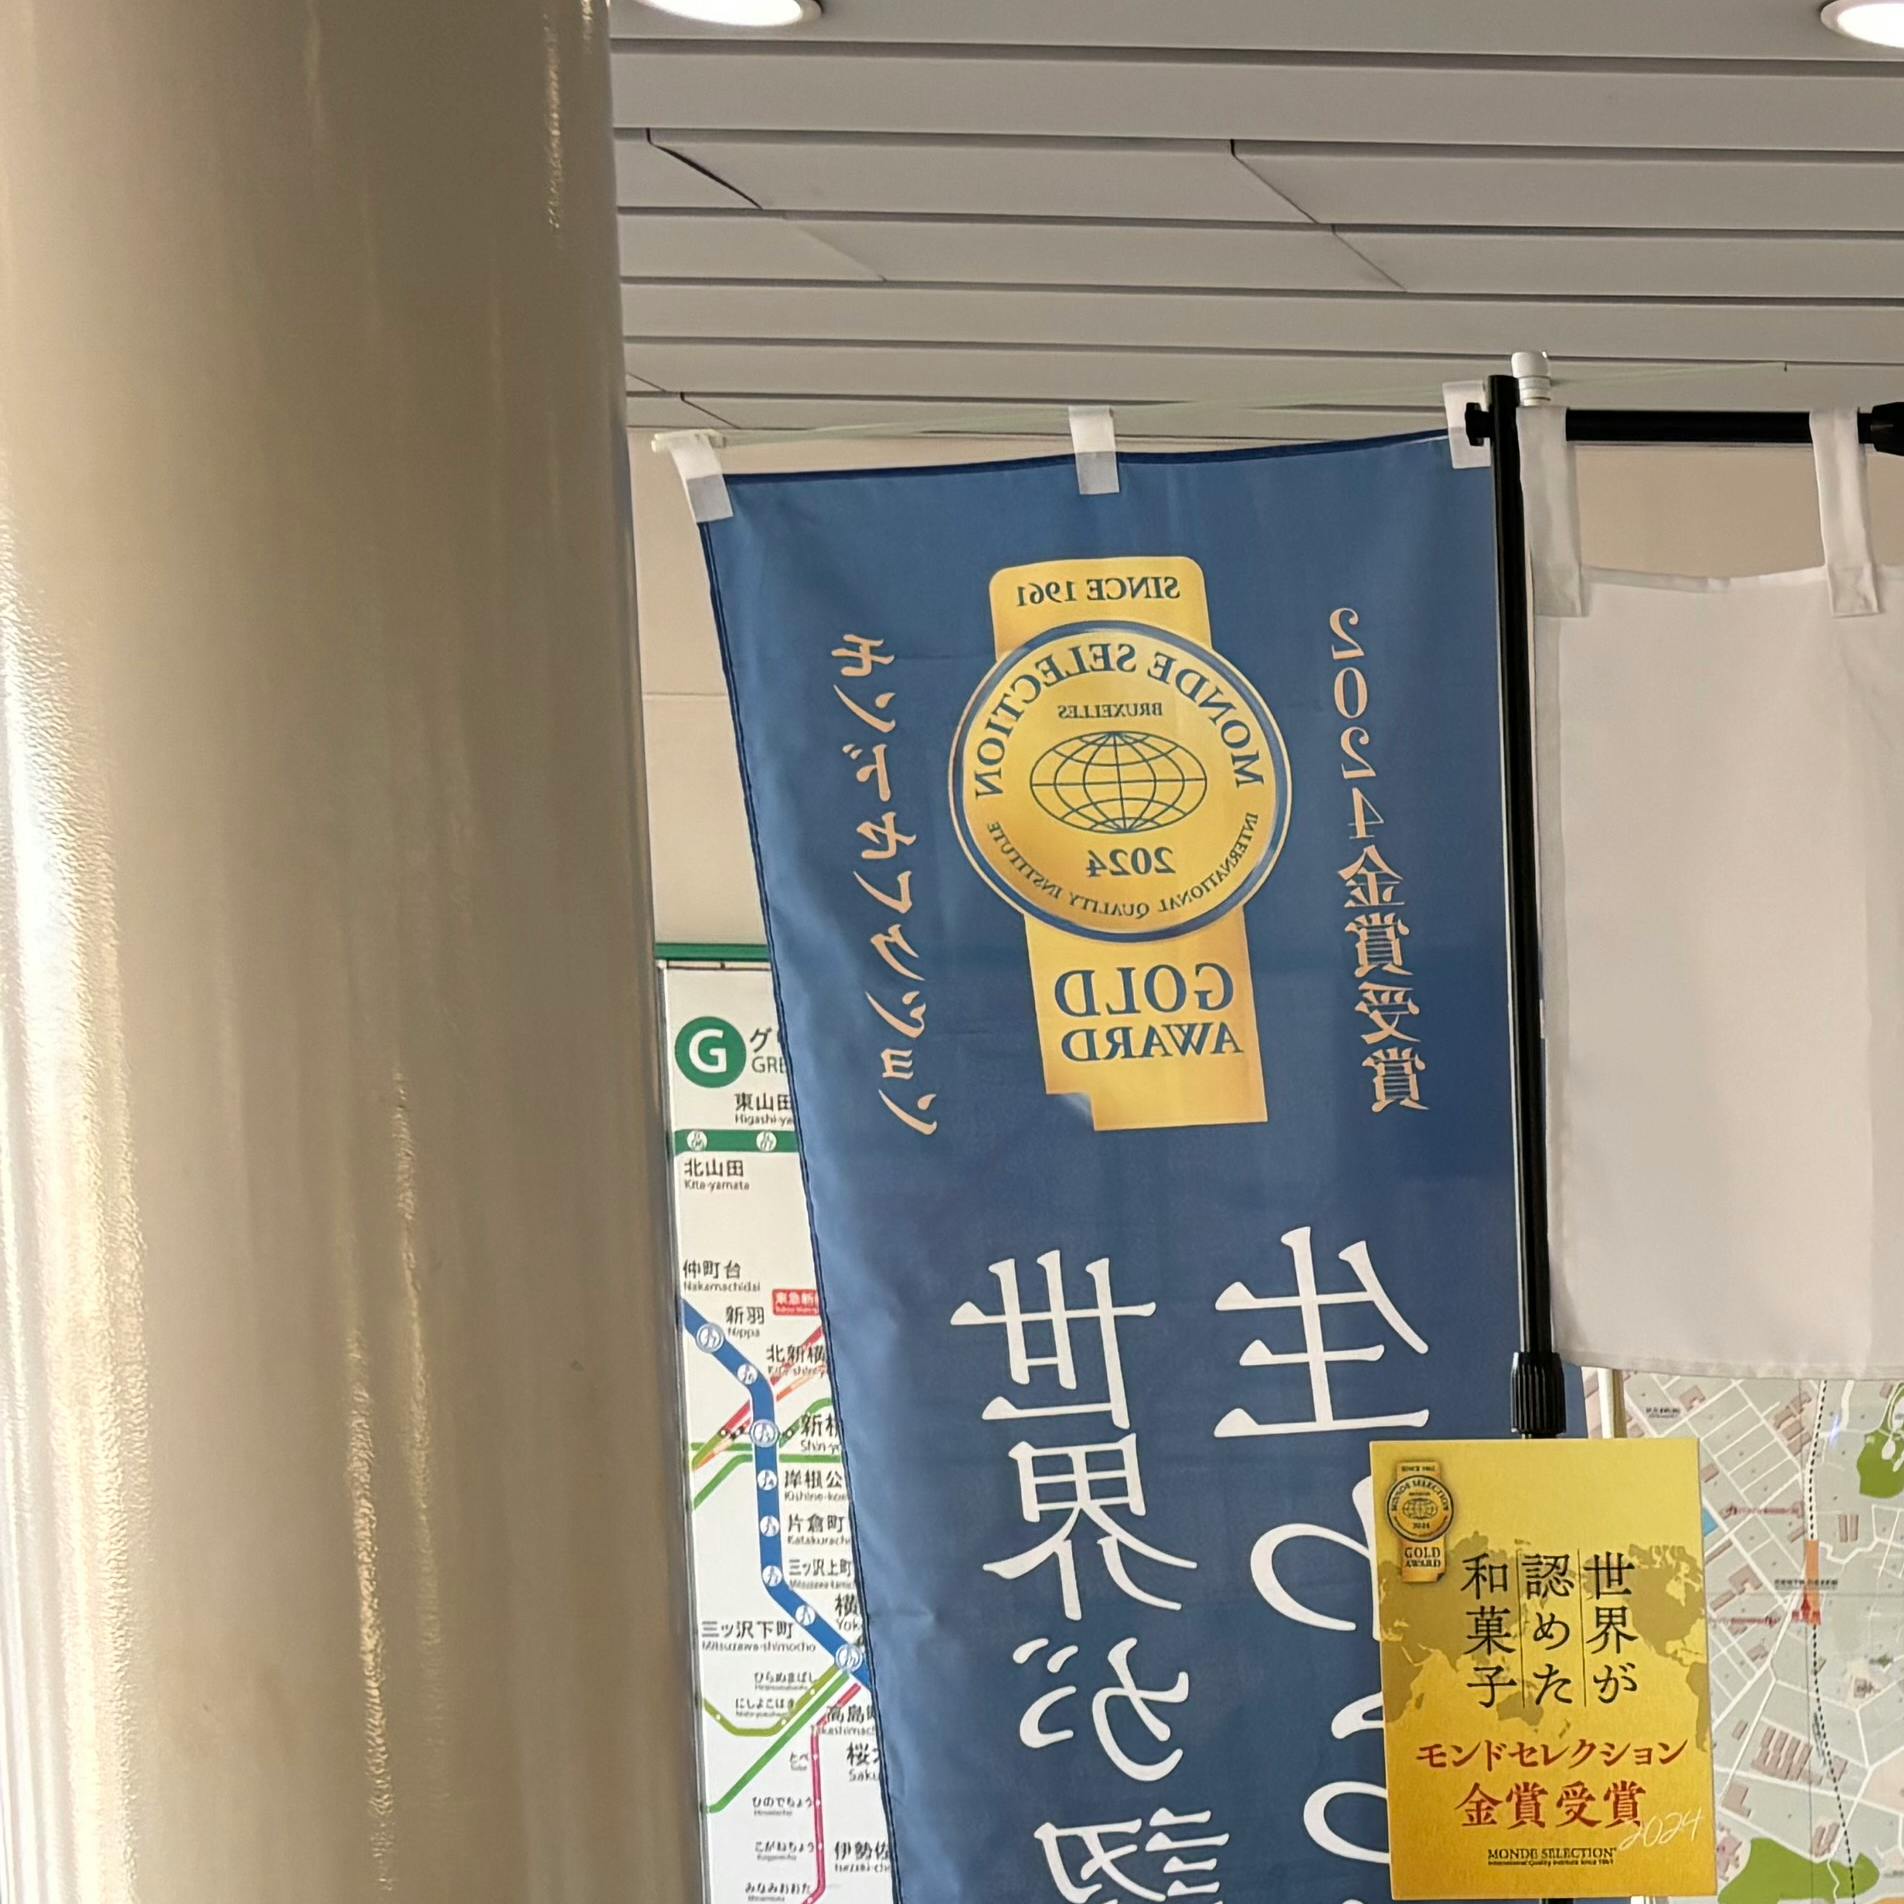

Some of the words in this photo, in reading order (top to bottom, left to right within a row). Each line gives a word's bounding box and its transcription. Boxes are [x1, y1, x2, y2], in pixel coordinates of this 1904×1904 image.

[688, 1029, 727, 1073] G
[684, 1159, 744, 1177] 北山田
[683, 1260, 741, 1279] 仲町台
[725, 1306, 764, 1325] 新羽
[1405, 1547, 1440, 1559] GOLD
[1461, 1552, 1516, 1708] 和菓子
[1524, 1554, 1574, 1706] 認めた
[1584, 1552, 1638, 1703] 世界が
[1417, 1739, 1688, 1771] モンドセレクション
[1455, 1780, 1647, 1828] 金賞受賞
[1619, 1807, 1702, 1850] 2024
[1488, 1848, 1537, 1860] MONDE
[1541, 1848, 1613, 1860] SELECTION
